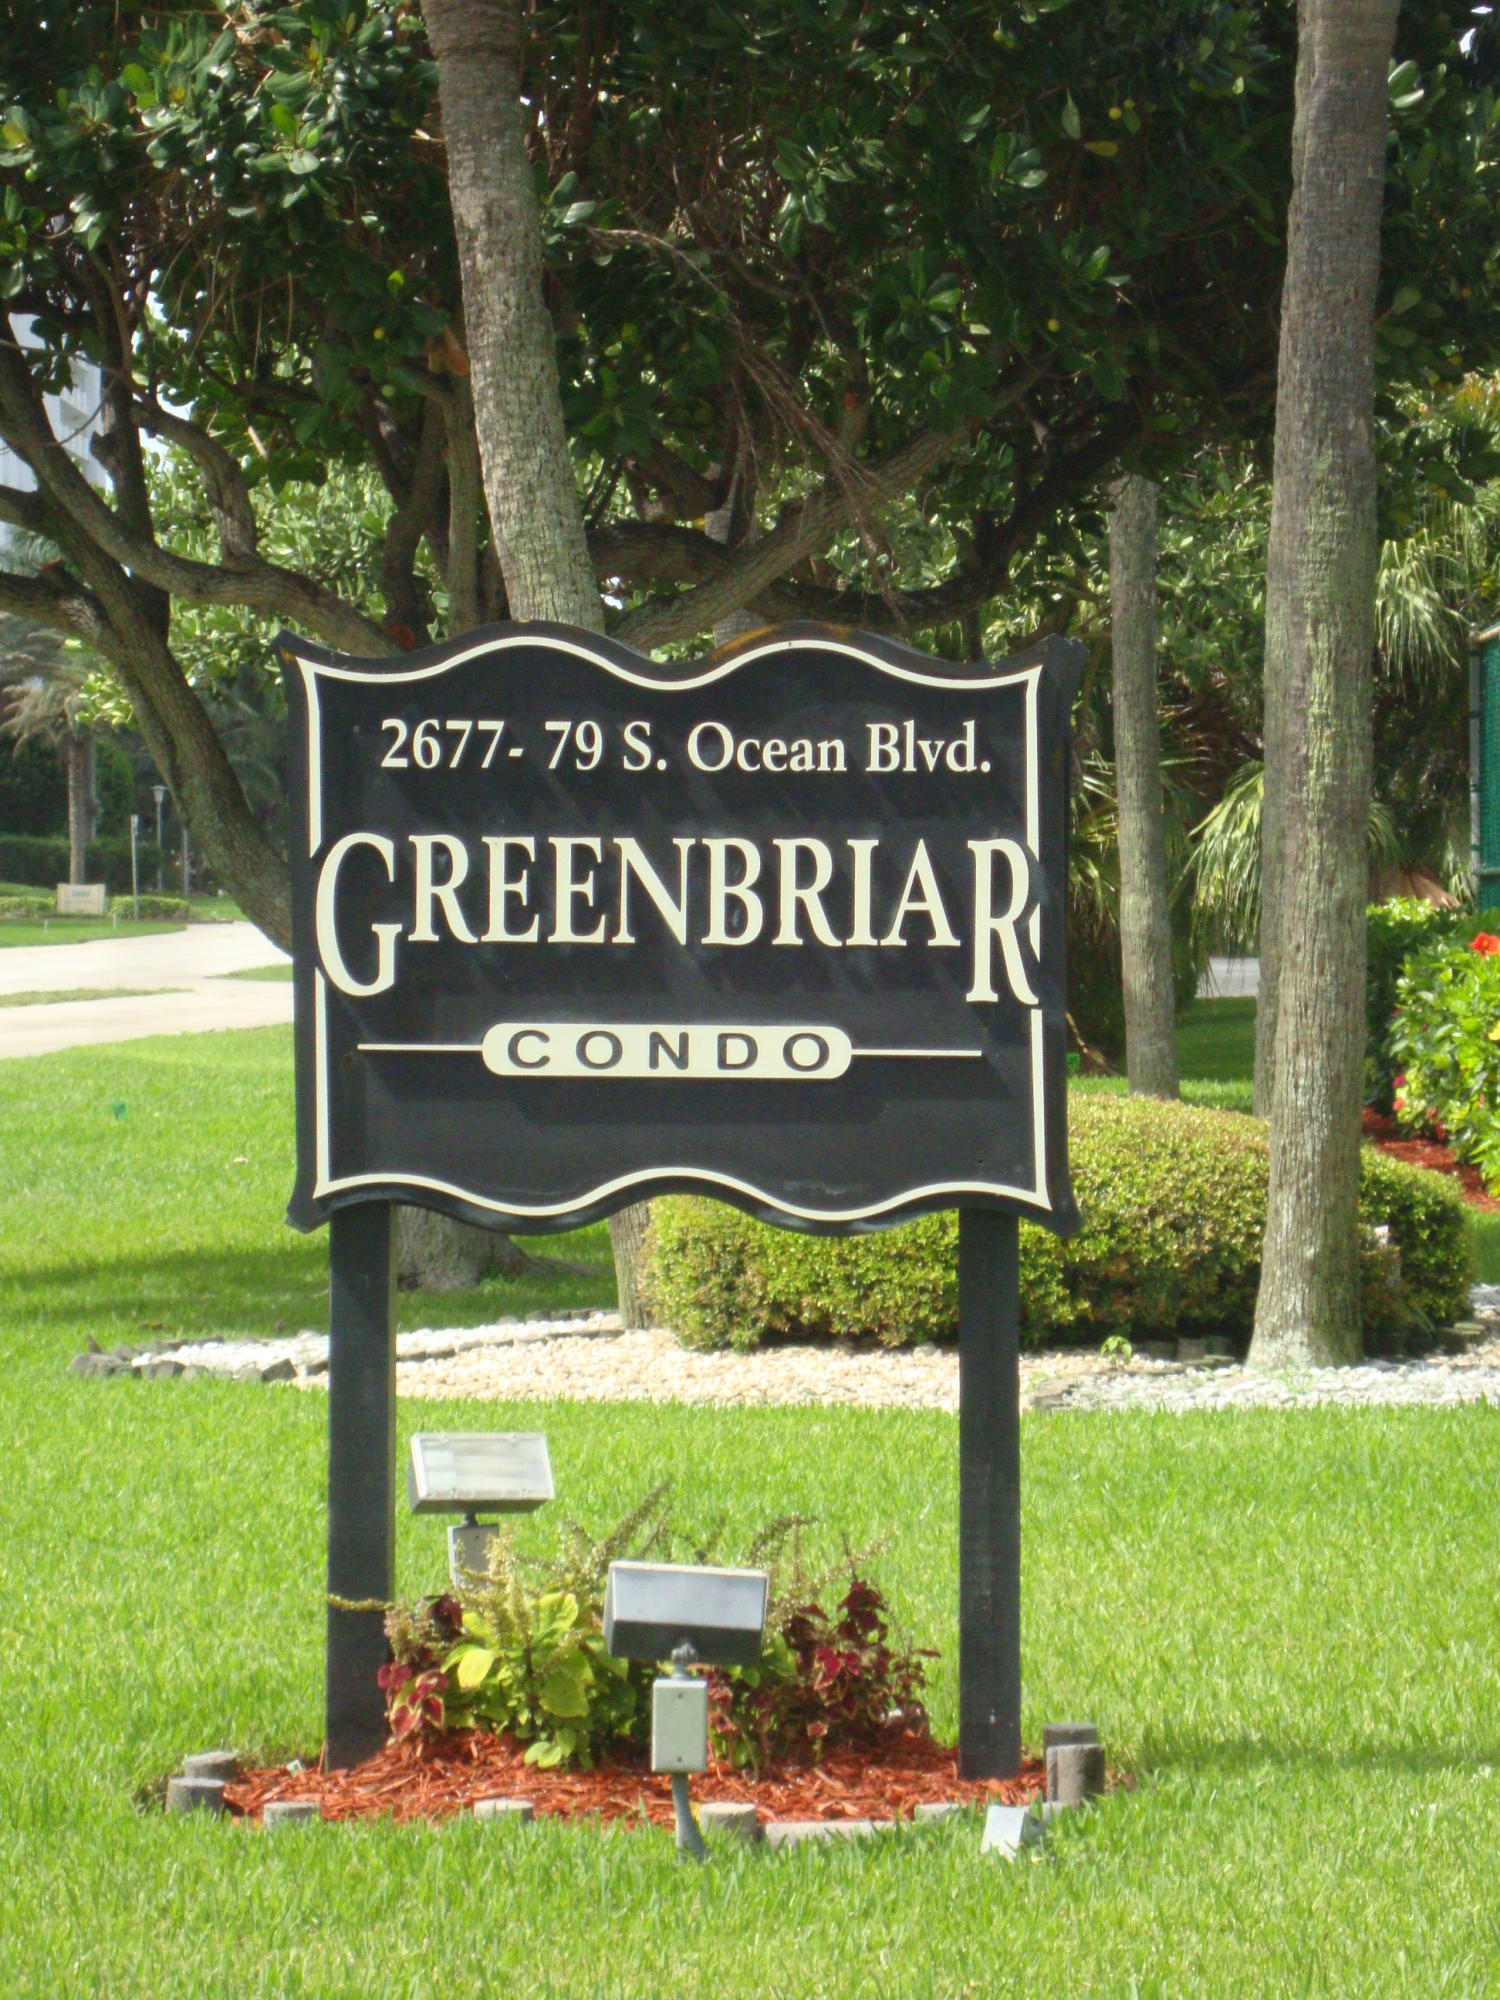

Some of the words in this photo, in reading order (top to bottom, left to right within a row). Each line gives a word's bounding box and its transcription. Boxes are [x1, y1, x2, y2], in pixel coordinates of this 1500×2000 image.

[623, 722, 667, 772] S.
[687, 721, 848, 772] Ocean
[864, 720, 991, 773] Blvd.
[315, 831, 1041, 1006] GREENBRIAR
[507, 1029, 830, 1072] CONDO
